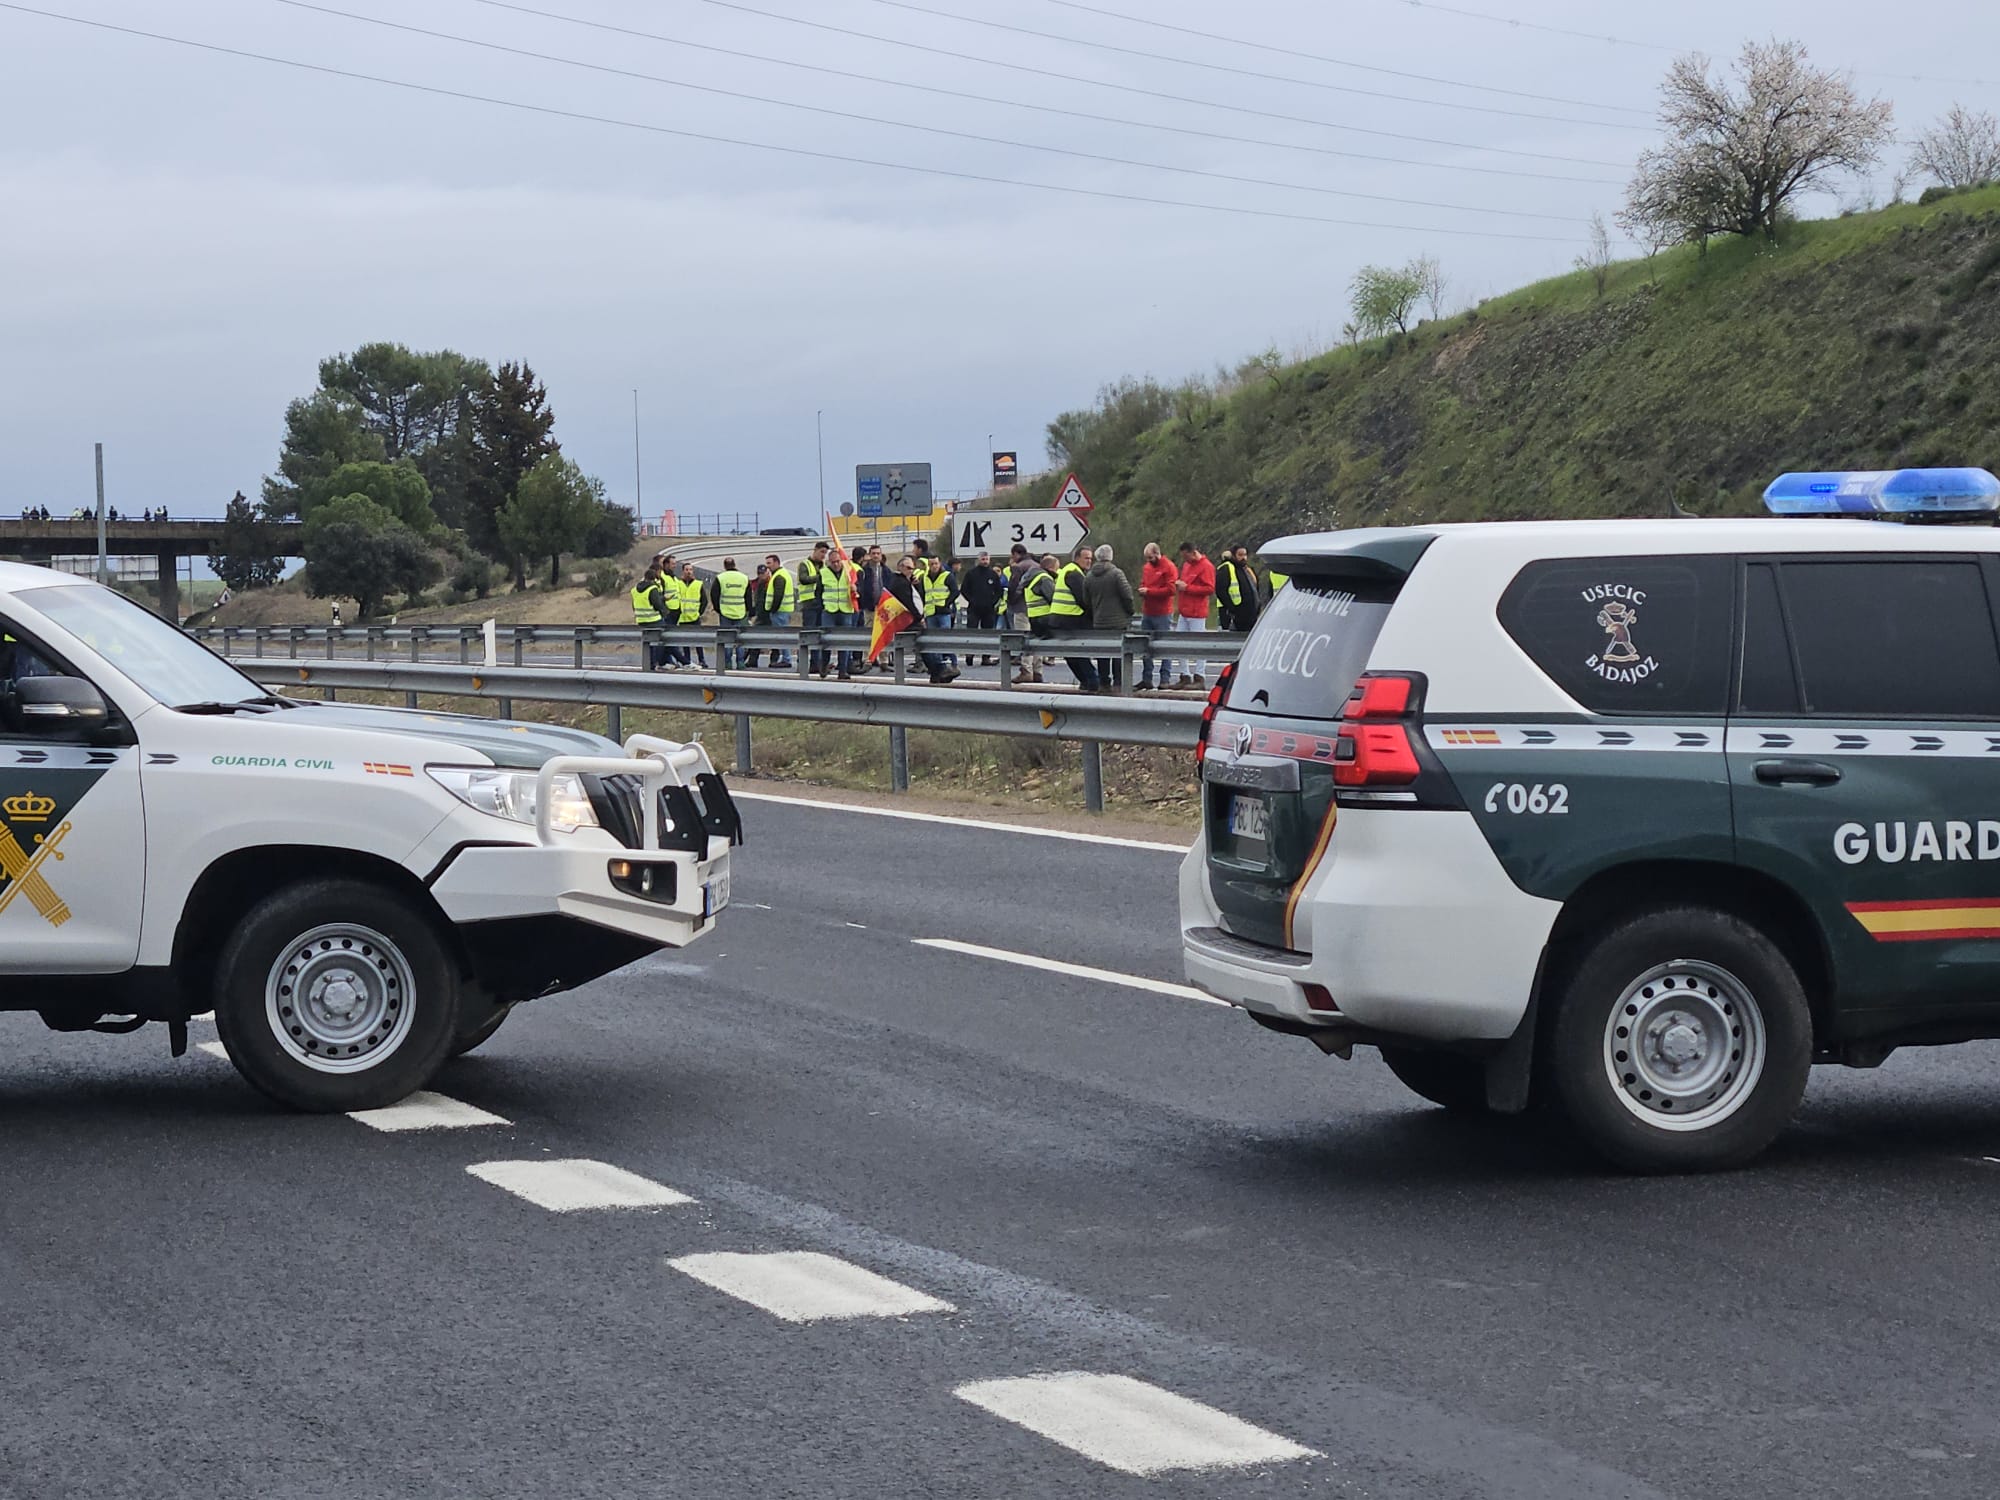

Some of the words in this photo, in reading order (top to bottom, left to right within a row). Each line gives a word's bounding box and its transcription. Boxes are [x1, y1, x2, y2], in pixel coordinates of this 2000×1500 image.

[1011, 523, 1060, 542] 341
[1581, 583, 1647, 605] USECIC
[1248, 628, 1332, 678] USECIC
[1585, 654, 1660, 685] BADAJOZ
[211, 755, 288, 768] GUARDIA
[294, 758, 336, 770] CIVIL
[1506, 783, 1569, 814] 062
[1833, 820, 2000, 865] GUARD
